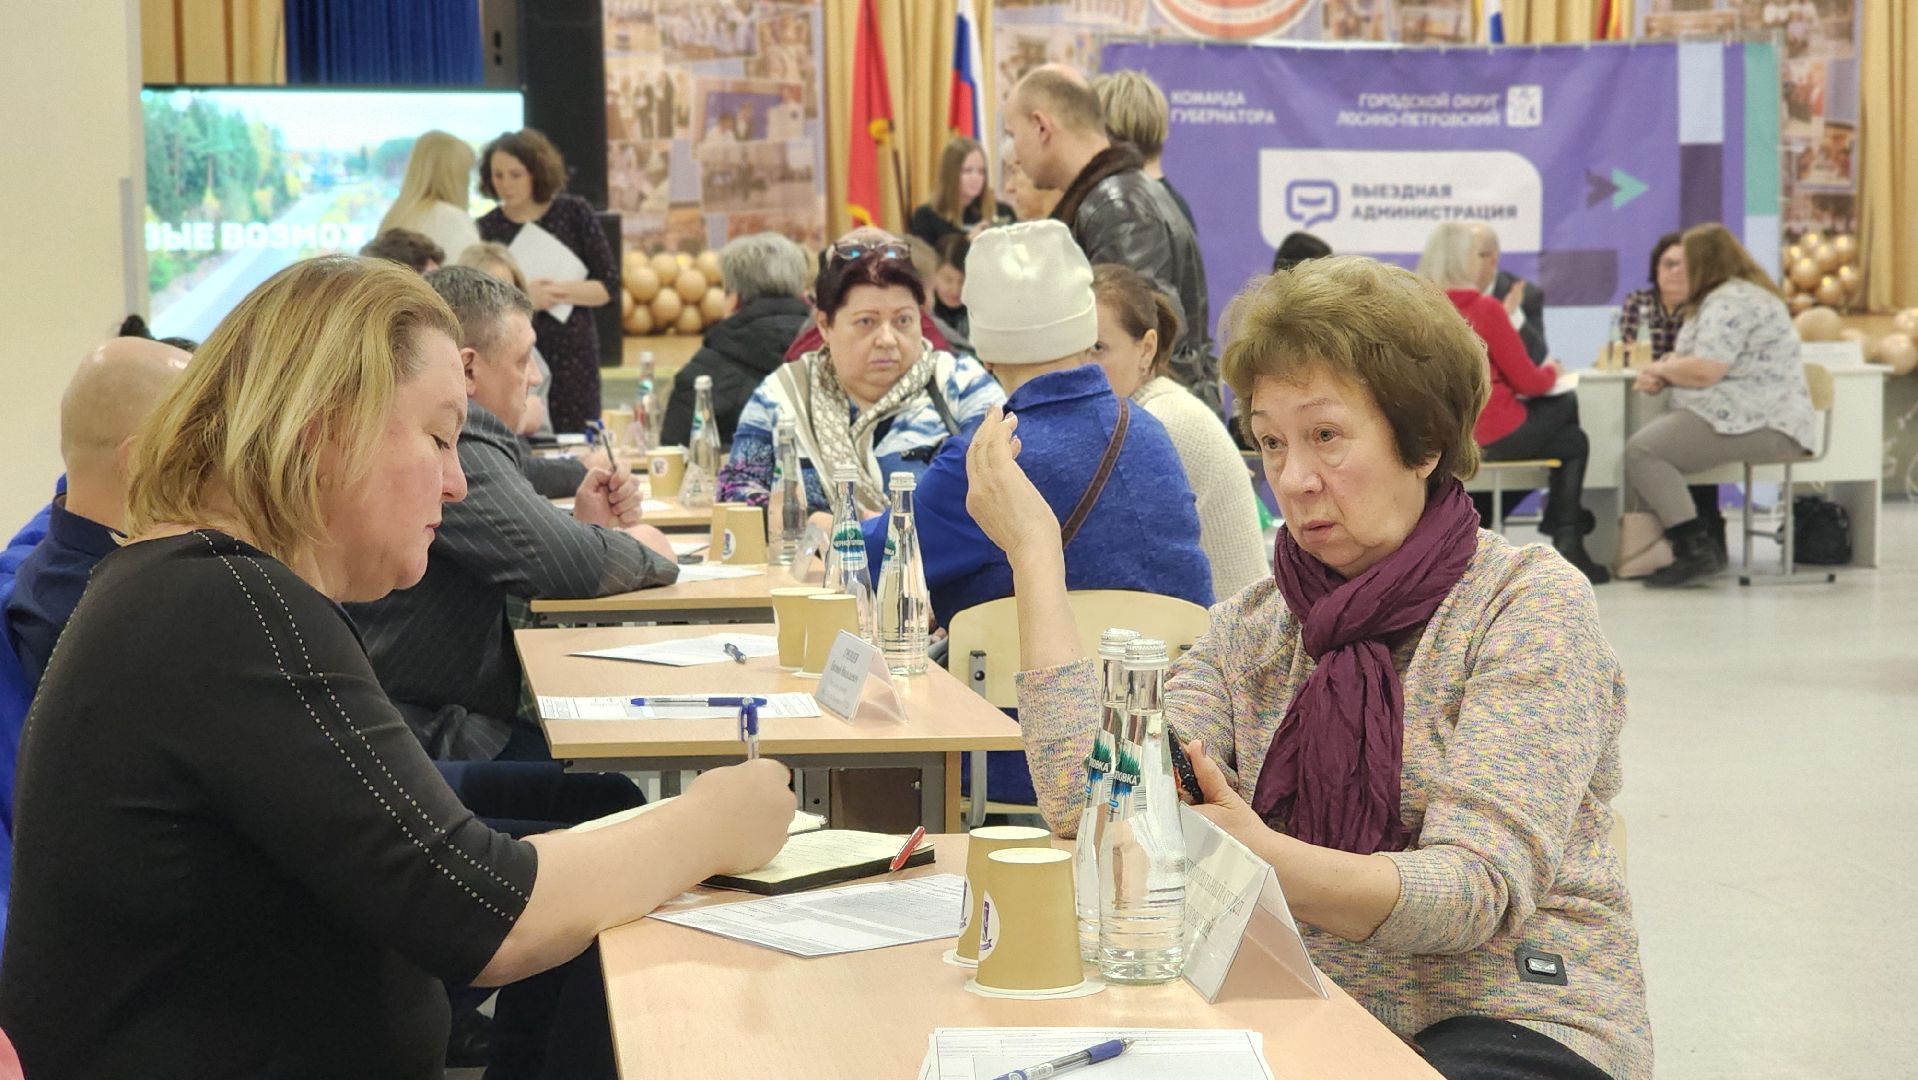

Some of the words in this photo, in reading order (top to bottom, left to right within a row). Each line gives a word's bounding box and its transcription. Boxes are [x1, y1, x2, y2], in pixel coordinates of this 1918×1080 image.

[1170, 90, 1247, 106] КОМАНДА
[1358, 92, 1449, 110] ГОРОДСКОЙ
[1452, 93, 1500, 108] ОКРУГ
[1170, 108, 1277, 124] ГУБЕРНАТОРА
[1337, 110, 1500, 126] ЛОСИНО-ПЕТРОВСКИЙ
[1351, 184, 1453, 200] ВЫЕЗДНАЯ
[1351, 205, 1519, 220] АДМИНИСТРАЦИЯ
